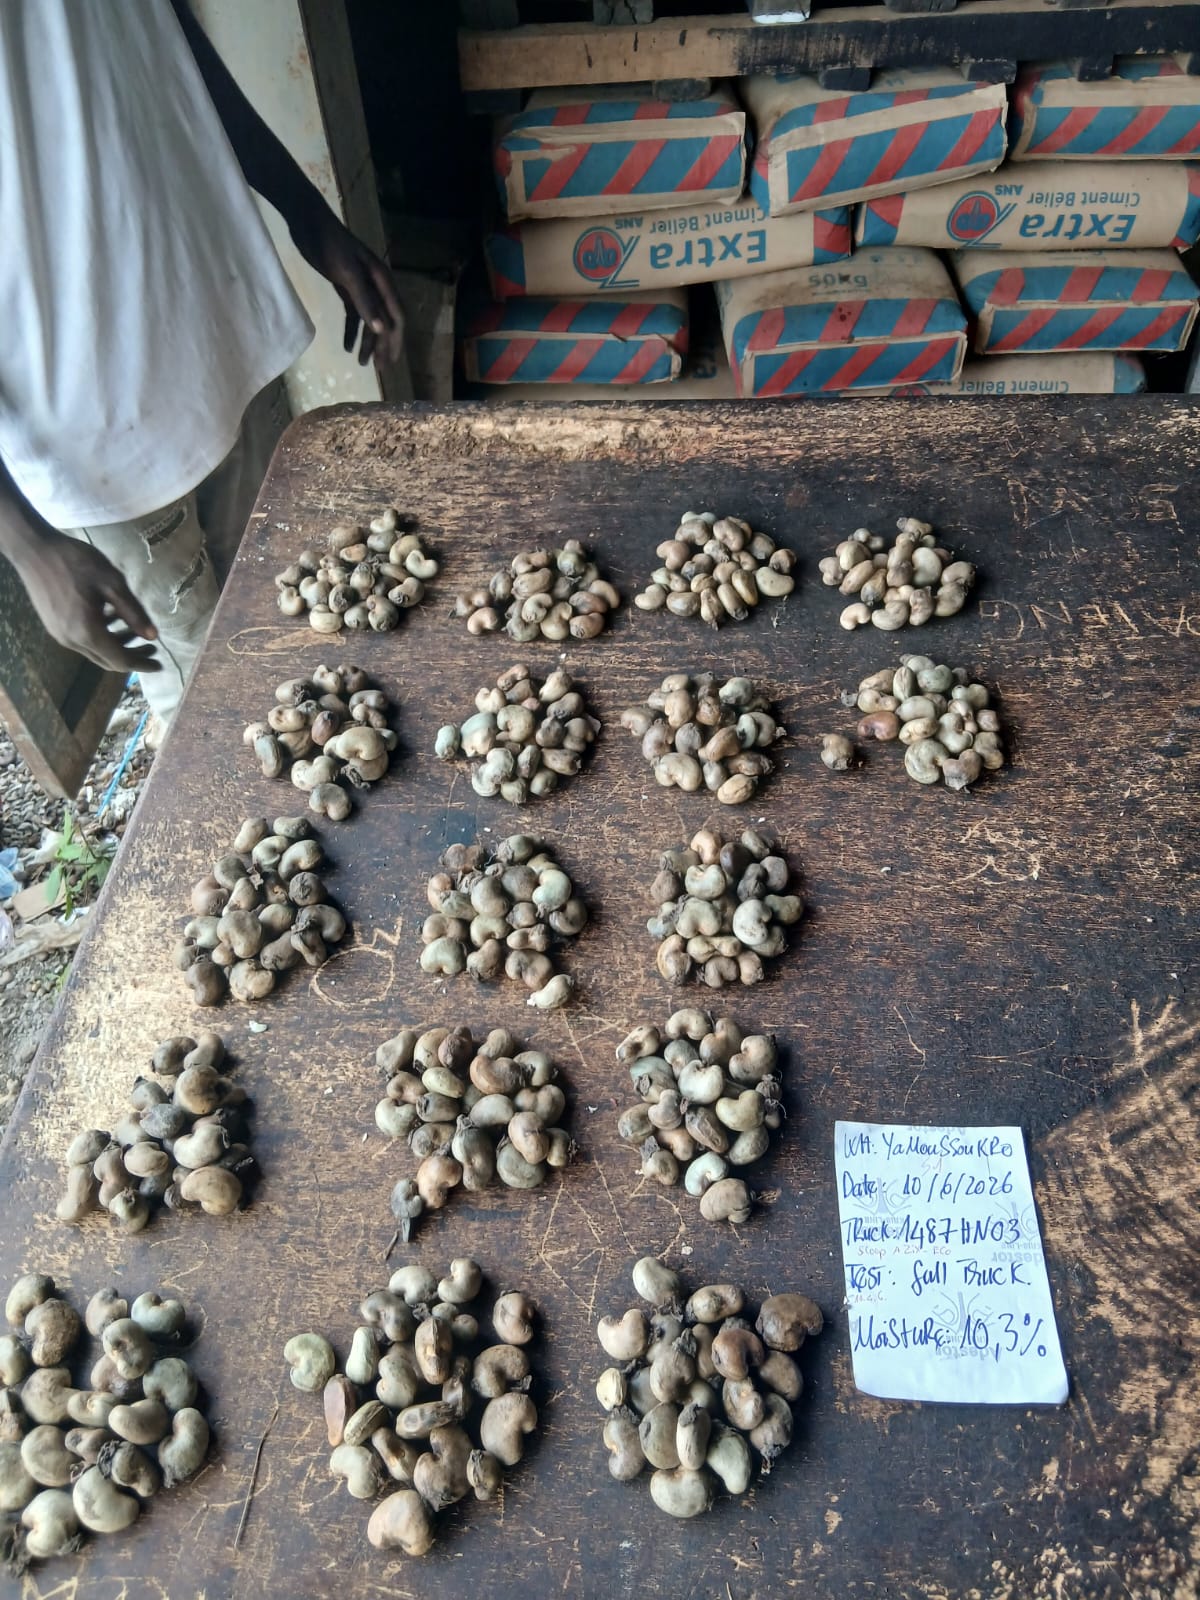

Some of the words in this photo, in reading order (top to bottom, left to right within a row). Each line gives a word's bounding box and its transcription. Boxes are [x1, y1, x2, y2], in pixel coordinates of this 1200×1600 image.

[994, 184, 1024, 196] ANS
[1026, 192, 1076, 208] Bélier
[1081, 192, 1140, 207] Ciment
[615, 216, 643, 230] ANS
[650, 216, 699, 235] Bélier
[705, 207, 767, 227] Ciment
[1019, 213, 1136, 242] Extra
[649, 229, 767, 269] Extra
[1011, 381, 1069, 394] Ciment
[843, 1171, 886, 1198] Date:
